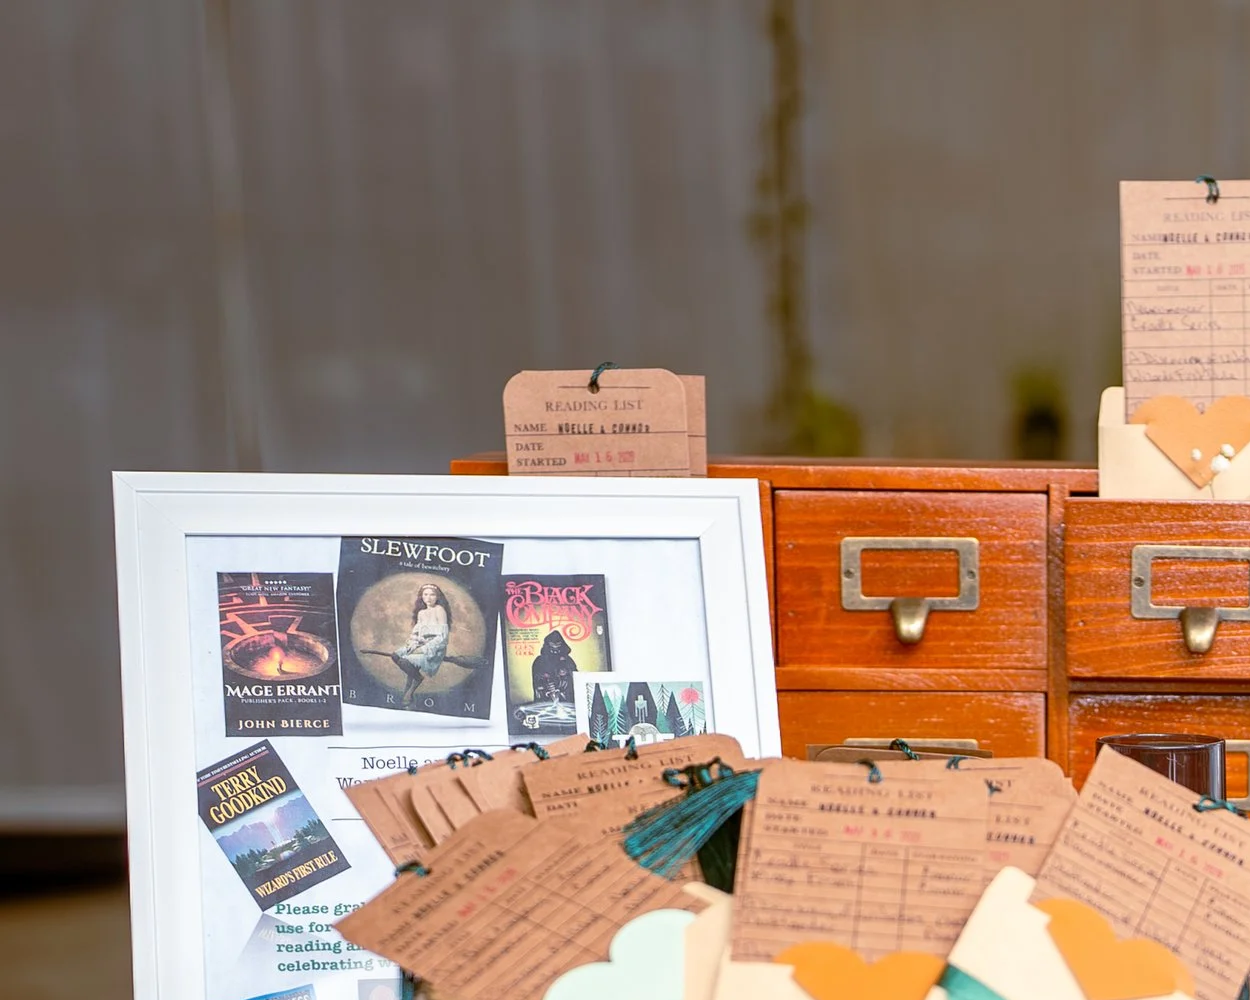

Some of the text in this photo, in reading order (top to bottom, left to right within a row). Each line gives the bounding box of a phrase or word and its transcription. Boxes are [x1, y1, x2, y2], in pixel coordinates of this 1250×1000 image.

[1163, 211, 1225, 223] READING
[1132, 251, 1161, 261] DATE
[1132, 266, 1182, 275] STARTED
[545, 399, 645, 413] READING LIST
[514, 423, 548, 433] NAME
[557, 422, 594, 435] NOELLE
[515, 442, 545, 452] DATE
[516, 457, 567, 468] STARTED
[360, 536, 491, 569] SLEWFOOT
[518, 580, 602, 610] BLACK
[225, 684, 340, 699] MAGE ERRANT
[238, 719, 330, 730] JOHN BIERCE
[361, 756, 418, 770] Noelle
[577, 752, 696, 780] READING LIST
[211, 765, 262, 801] TERRY
[210, 775, 287, 824] GOODKIND
[542, 786, 582, 799] NAME
[254, 850, 338, 900] WIZARD'S FIRST RULE
[275, 901, 366, 916] Please gra
[275, 921, 333, 934] use for
[276, 939, 342, 955] reading
[277, 958, 374, 972] celebrating
